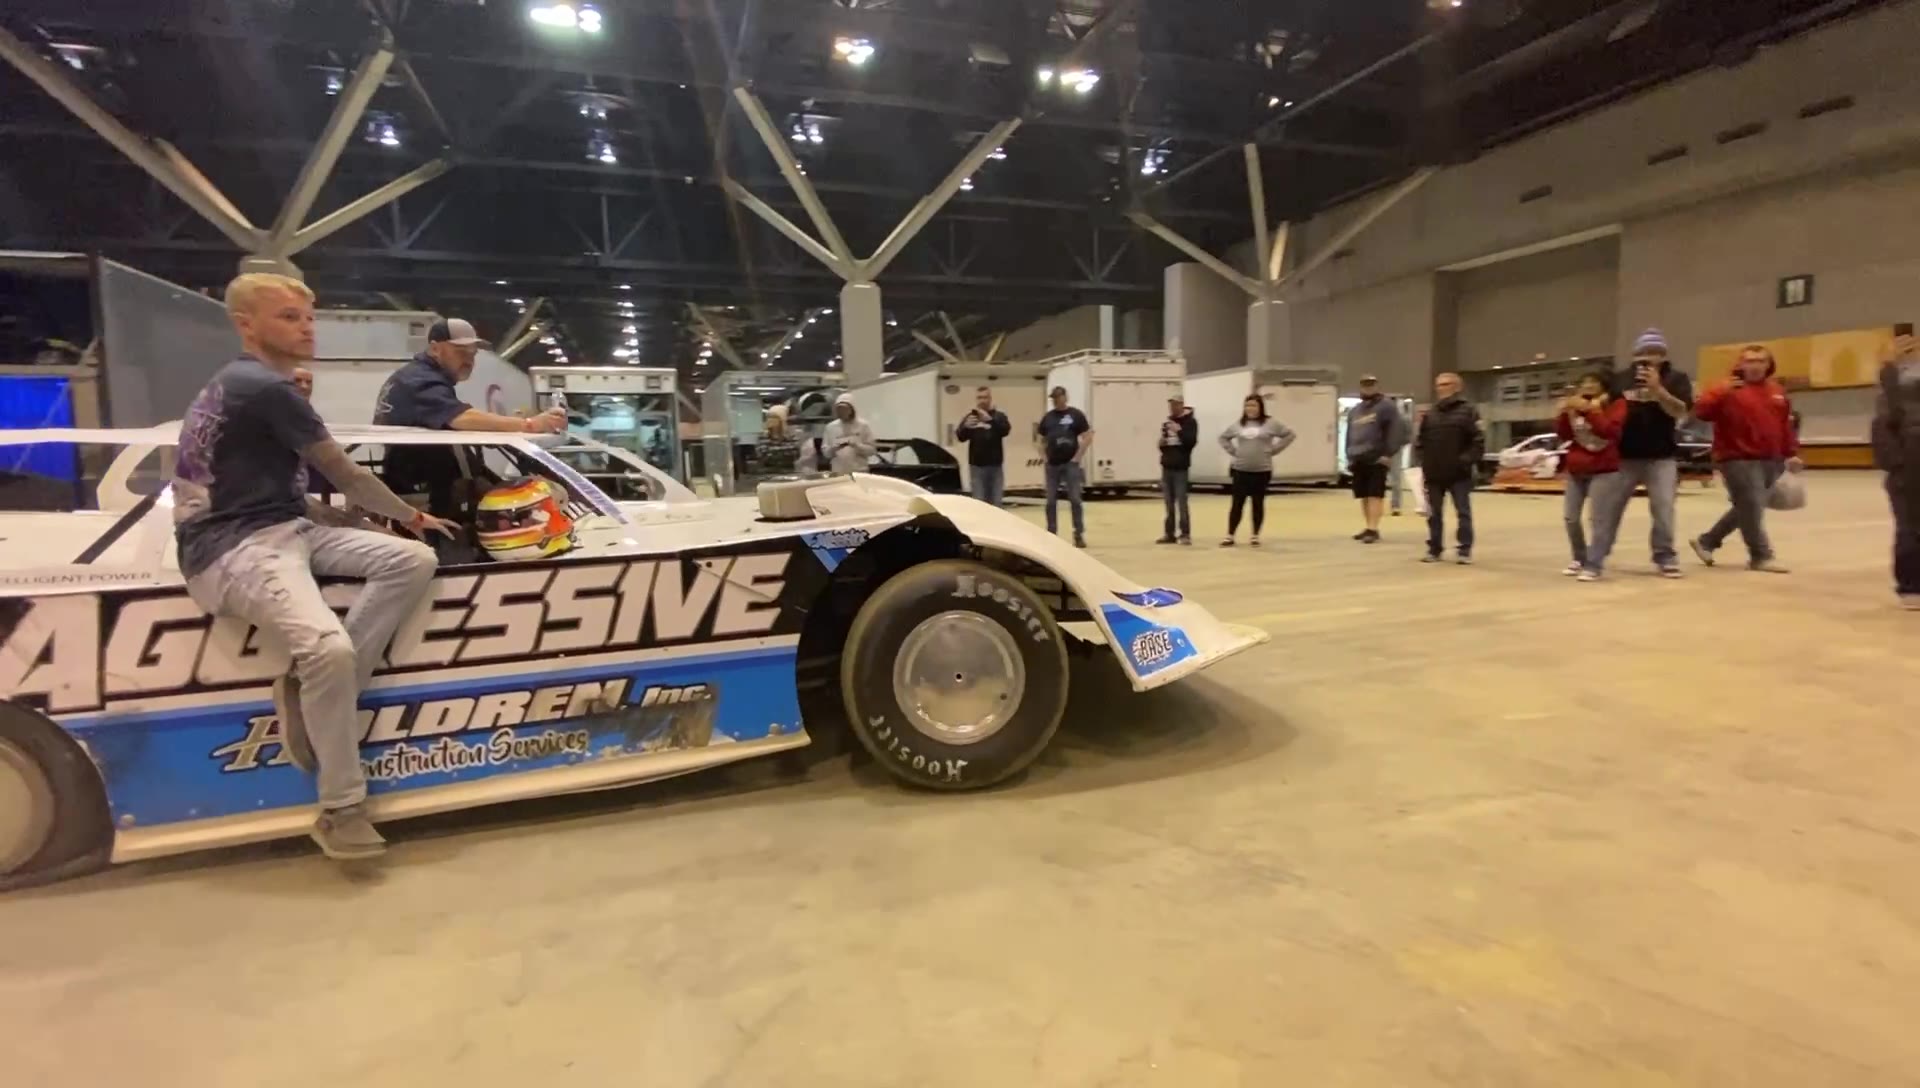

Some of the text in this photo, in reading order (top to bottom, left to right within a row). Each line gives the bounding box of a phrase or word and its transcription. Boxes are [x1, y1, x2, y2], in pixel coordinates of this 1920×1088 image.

[89, 572, 152, 582] POWER
[0, 552, 792, 711] AGGESSIVE
[1140, 632, 1172, 661] BASE
[489, 728, 590, 764] Services
